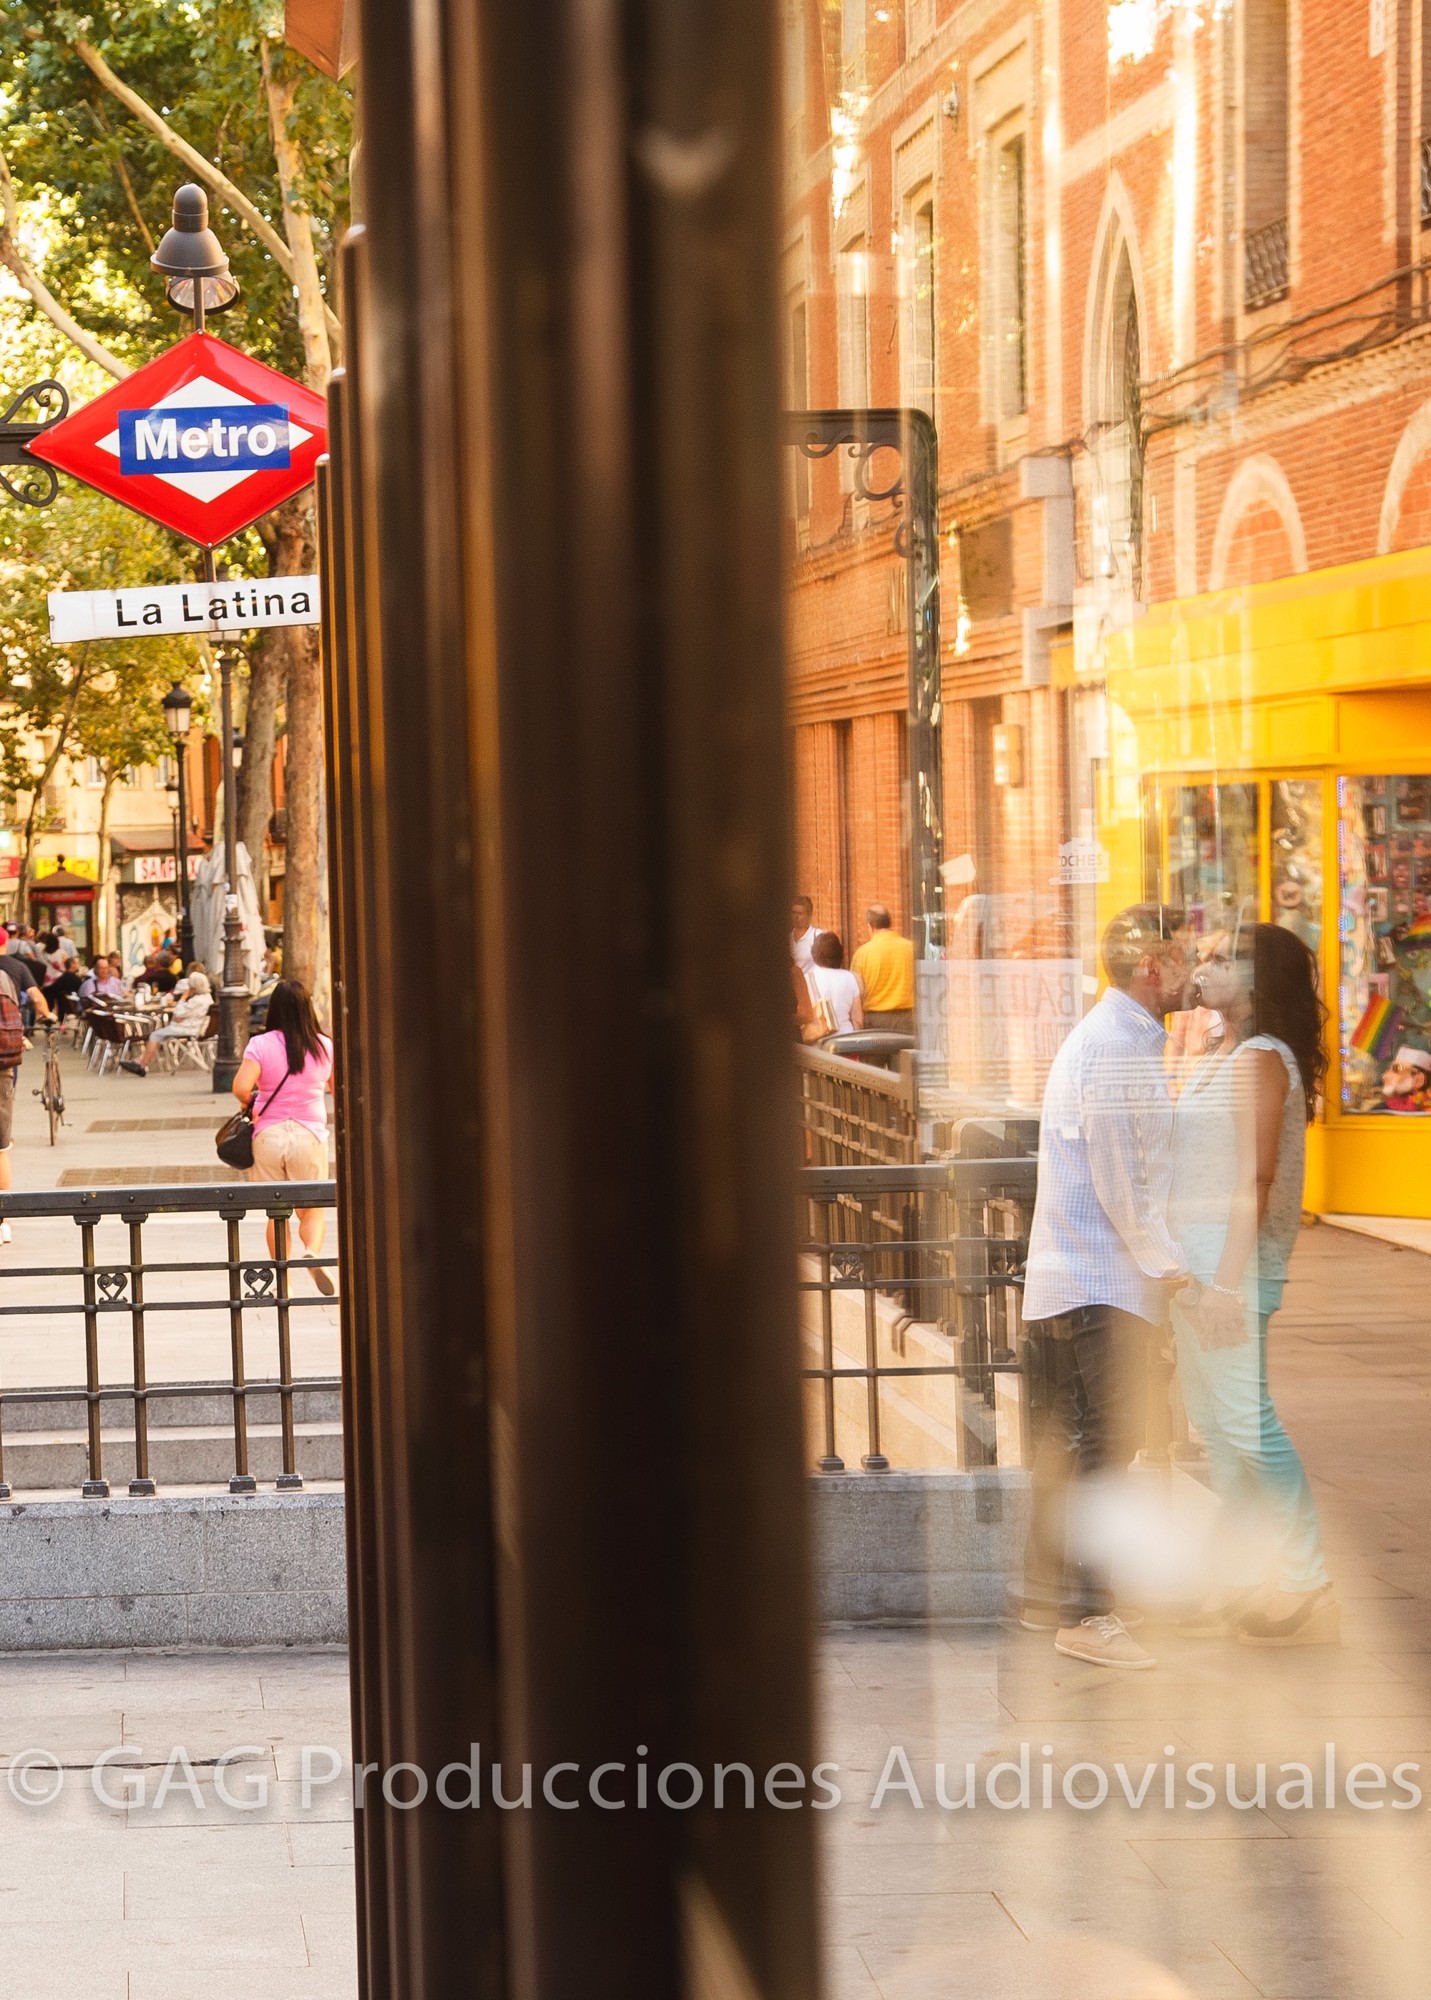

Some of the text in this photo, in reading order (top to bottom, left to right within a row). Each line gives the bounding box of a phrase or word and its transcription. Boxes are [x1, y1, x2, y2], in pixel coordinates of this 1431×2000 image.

[135, 418, 278, 461] Metro
[116, 588, 311, 627] La Latina
